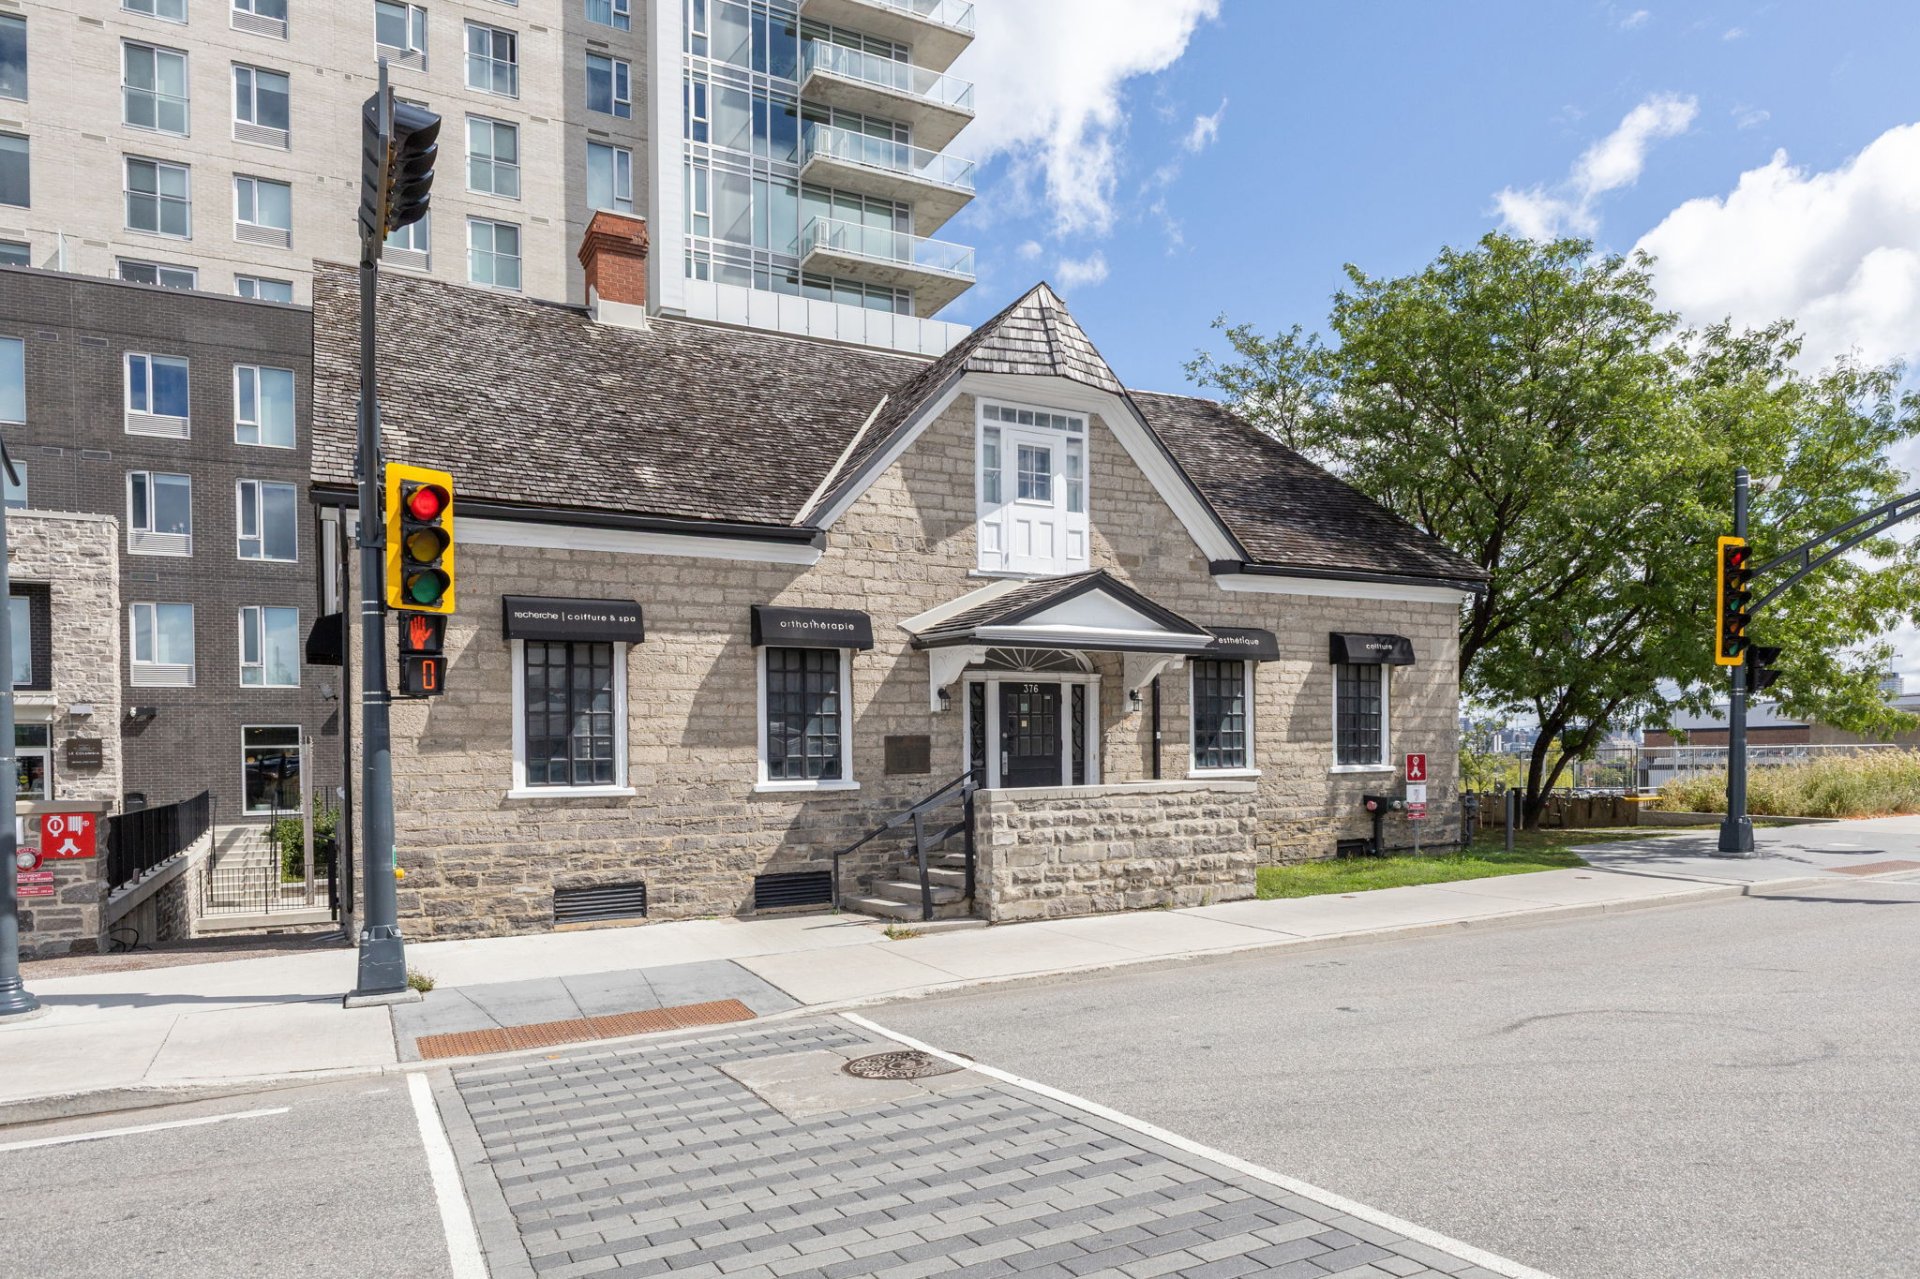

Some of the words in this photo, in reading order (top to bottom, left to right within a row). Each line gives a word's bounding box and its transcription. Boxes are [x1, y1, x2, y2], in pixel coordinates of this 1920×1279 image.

[514, 611, 558, 620] recherche
[567, 613, 607, 622] coiffure
[609, 614, 616, 622] &
[619, 615, 636, 623] spa
[1023, 684, 1039, 694] 376
